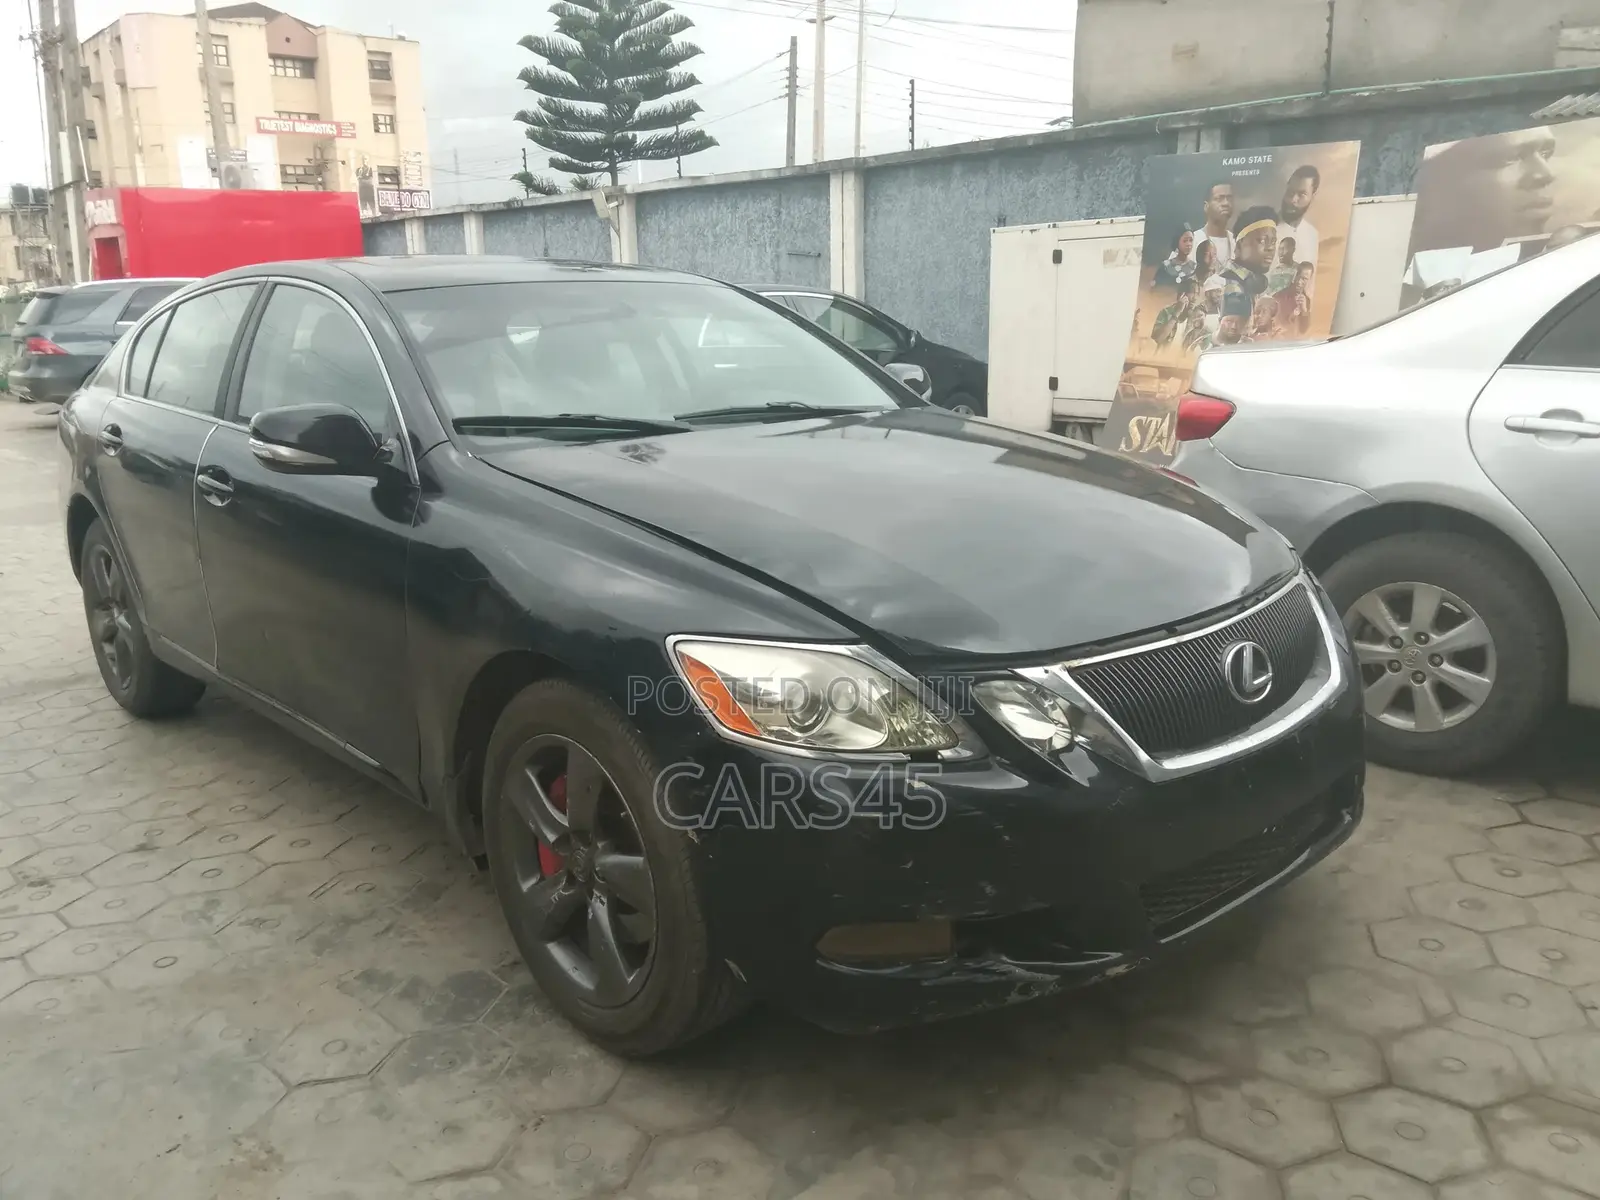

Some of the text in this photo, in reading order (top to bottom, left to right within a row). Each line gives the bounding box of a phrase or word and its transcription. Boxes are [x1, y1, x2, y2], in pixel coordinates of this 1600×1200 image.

[1222, 154, 1273, 166] KAMO STATE
[1231, 169, 1260, 177] PRESENTS
[412, 191, 430, 209] GYM
[1118, 412, 1176, 457] STA
